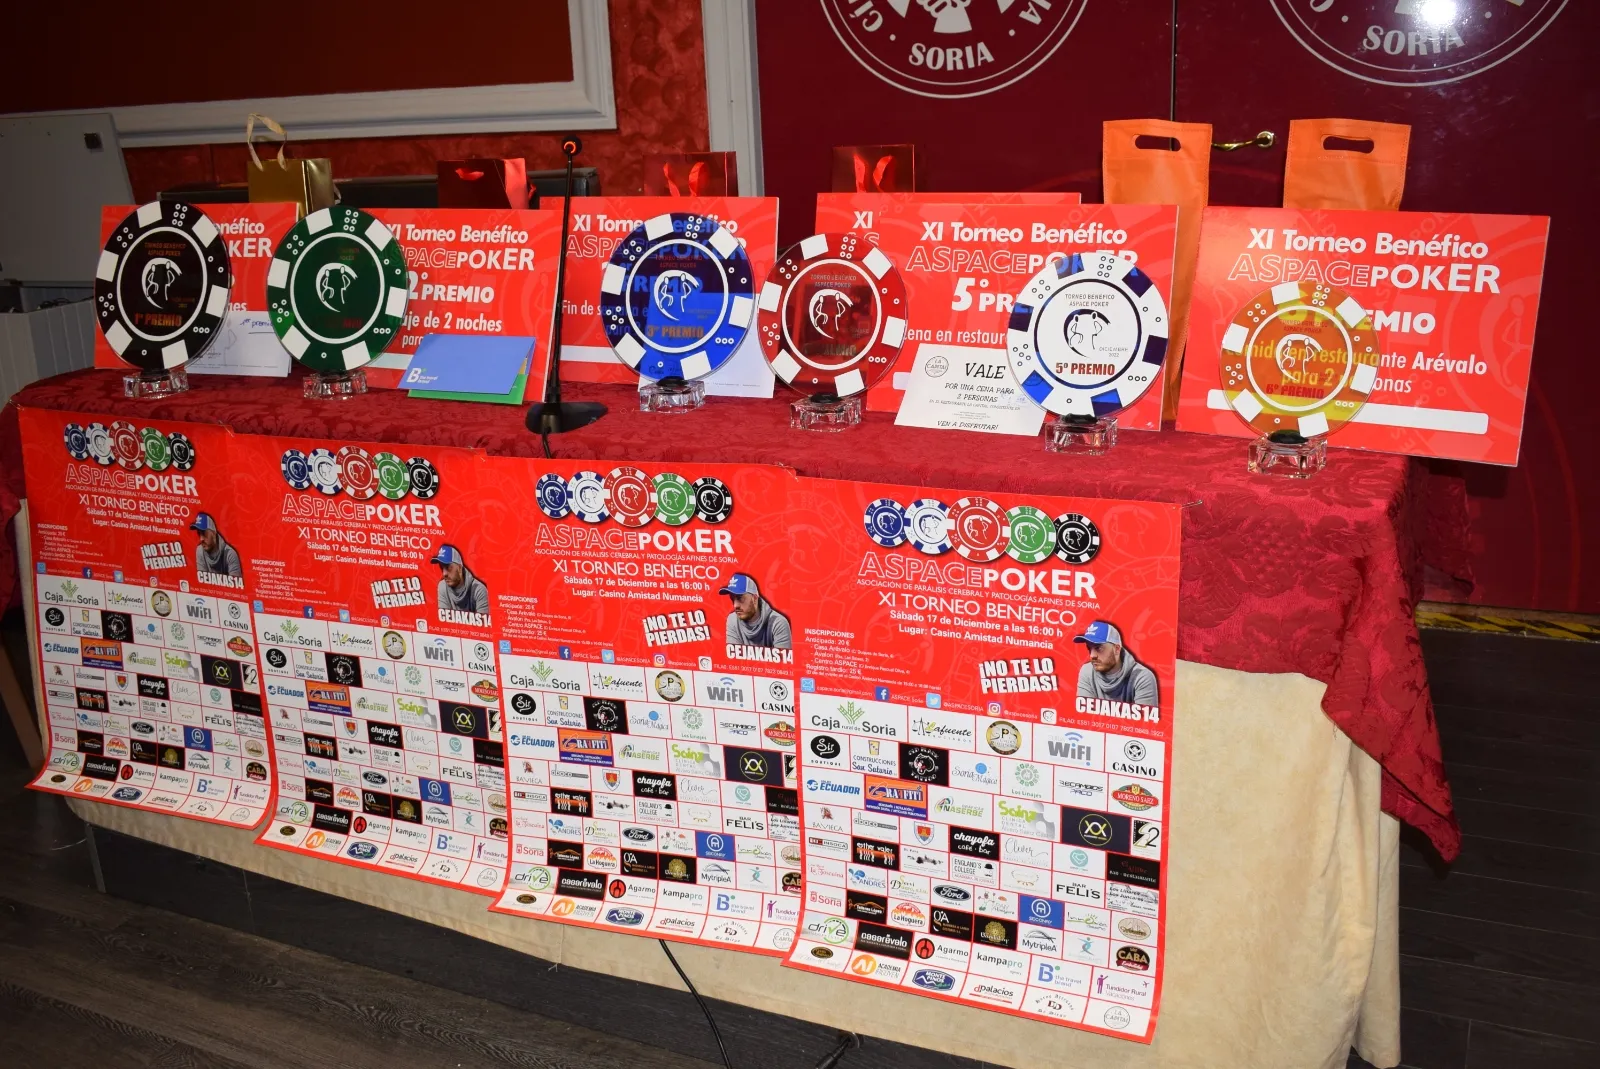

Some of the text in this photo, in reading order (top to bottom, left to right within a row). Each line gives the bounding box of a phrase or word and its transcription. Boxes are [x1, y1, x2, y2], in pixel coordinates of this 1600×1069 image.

[1362, 25, 1465, 56] SORIA
[909, 42, 995, 70] SORIA
[573, 214, 591, 232] XI
[852, 211, 872, 229] XI
[406, 224, 528, 243] Torneo Benéfico
[920, 222, 1127, 245] XI Torneo Benéfico
[1247, 227, 1489, 259] XI Torneo Benéfico
[421, 284, 494, 303] PREMIO
[561, 299, 594, 315] Fin de
[144, 314, 182, 326] PREMIO
[424, 311, 502, 332] de 2 noches
[661, 327, 704, 339] PREMIO
[936, 330, 952, 342] en
[1056, 363, 1115, 375] 5º PREMIO
[1412, 350, 1487, 375] Arévalo
[407, 368, 421, 382] B
[965, 363, 1006, 379] VALE
[1324, 368, 1335, 386] 2
[964, 394, 998, 402] PERSONAS
[1281, 385, 1324, 399] PREMIO
[959, 422, 998, 430] DISFRUTAR!
[65, 463, 199, 496] ASPACEPOKER
[79, 494, 190, 518] XI TORNEO BENÉFICO
[87, 508, 107, 517] Sábado
[282, 494, 442, 527] ASPACEPOKER
[298, 526, 431, 550] XI TORNEO BENÉFICO
[535, 522, 734, 554] ASPACEPOKER
[158, 543, 171, 556] TE
[171, 542, 182, 554] LO
[307, 542, 418, 560] Sábado 17 Diciembre 16:00
[143, 555, 187, 571] PIERDAS!
[335, 556, 418, 570] Casino Amistad Numancia
[718, 556, 738, 564] SORIA
[552, 559, 720, 580] XI TORNEO BENÉFICO
[858, 552, 1097, 599] ASPACEPOKER
[197, 571, 244, 590] CEJAKAS14
[393, 578, 405, 592] TE
[406, 577, 421, 591] LO
[564, 576, 593, 586] Sábado
[595, 578, 604, 586] 17
[606, 578, 616, 586] de
[618, 578, 658, 588] Diciembre
[666, 580, 678, 588] las
[680, 581, 701, 590] 16:00
[704, 582, 710, 590] h
[45, 591, 99, 605] Caja Soria
[374, 591, 425, 609] PIERDAS!
[572, 588, 703, 603] Lugar: Casino Amistad Numancia
[856, 578, 896, 590] ASOCIACIÓN
[898, 582, 909, 591] DE
[948, 587, 984, 598] CEREBRAL
[1038, 596, 1063, 606] AFINES
[1064, 598, 1076, 607] DE
[1077, 600, 1100, 609] SORIA
[878, 591, 1077, 627] XI TORNEO BENÉFICO
[224, 620, 248, 630] CASINO
[669, 612, 686, 628] TE
[687, 610, 706, 626] LO
[889, 609, 1063, 638] Sábado 17 de Diciembre a las 16:00 h
[264, 632, 322, 647] Caja Soria
[645, 626, 710, 648] PIERDAS!
[804, 628, 855, 638] INSCRIPCIONES
[898, 624, 1053, 650] Lugar: Casino Amistad Numancia
[1010, 659, 1032, 674] TE
[1033, 657, 1054, 674] LO
[510, 674, 581, 691] Caja Soria
[981, 675, 1058, 694] PIERDAS!
[1075, 697, 1160, 723] CEJAKAS14
[811, 715, 897, 736] Caja Soria
[522, 738, 555, 748] ECUADOR
[816, 738, 834, 754] Sir
[853, 755, 897, 766] CONSTRUCCIONES
[1112, 762, 1157, 776] CASINO
[637, 775, 672, 787] chayofa
[820, 782, 860, 795] ECUADOR
[954, 865, 976, 875] COLLEGE
[663, 889, 703, 901] kampapro
[818, 895, 842, 908] Soria
[939, 888, 964, 900] Ford
[937, 944, 969, 957] Agarmo
[1022, 939, 1057, 952] MytripleA
[977, 952, 1023, 969] kampapro
[1117, 950, 1148, 965] CABA
[1106, 984, 1147, 997] Tundidor Rural
